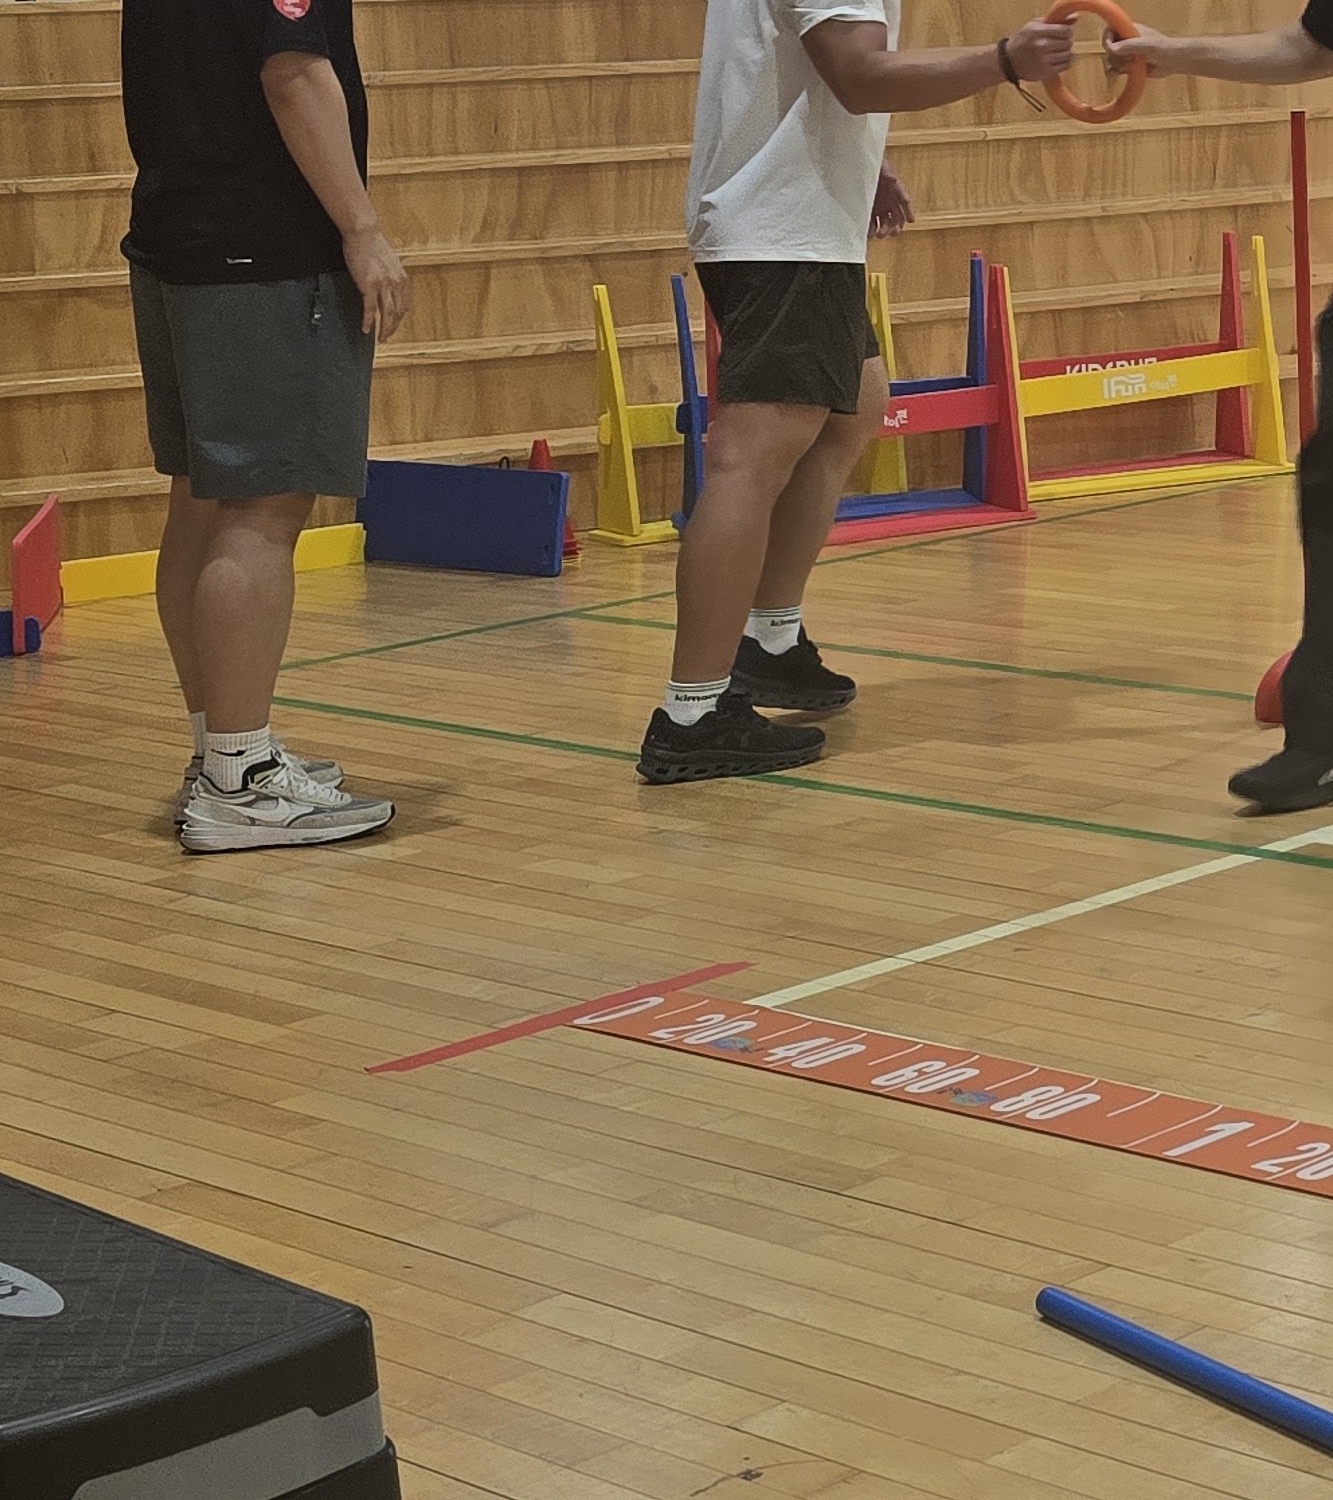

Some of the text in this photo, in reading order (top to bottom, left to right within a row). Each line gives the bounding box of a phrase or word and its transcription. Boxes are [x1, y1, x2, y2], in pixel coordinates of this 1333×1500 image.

[573, 996, 665, 1025] 0
[648, 1013, 757, 1045] 20
[763, 1037, 866, 1068] 40
[871, 1061, 980, 1093] 60
[989, 1086, 1101, 1120] 80
[1162, 1121, 1255, 1156] 1
